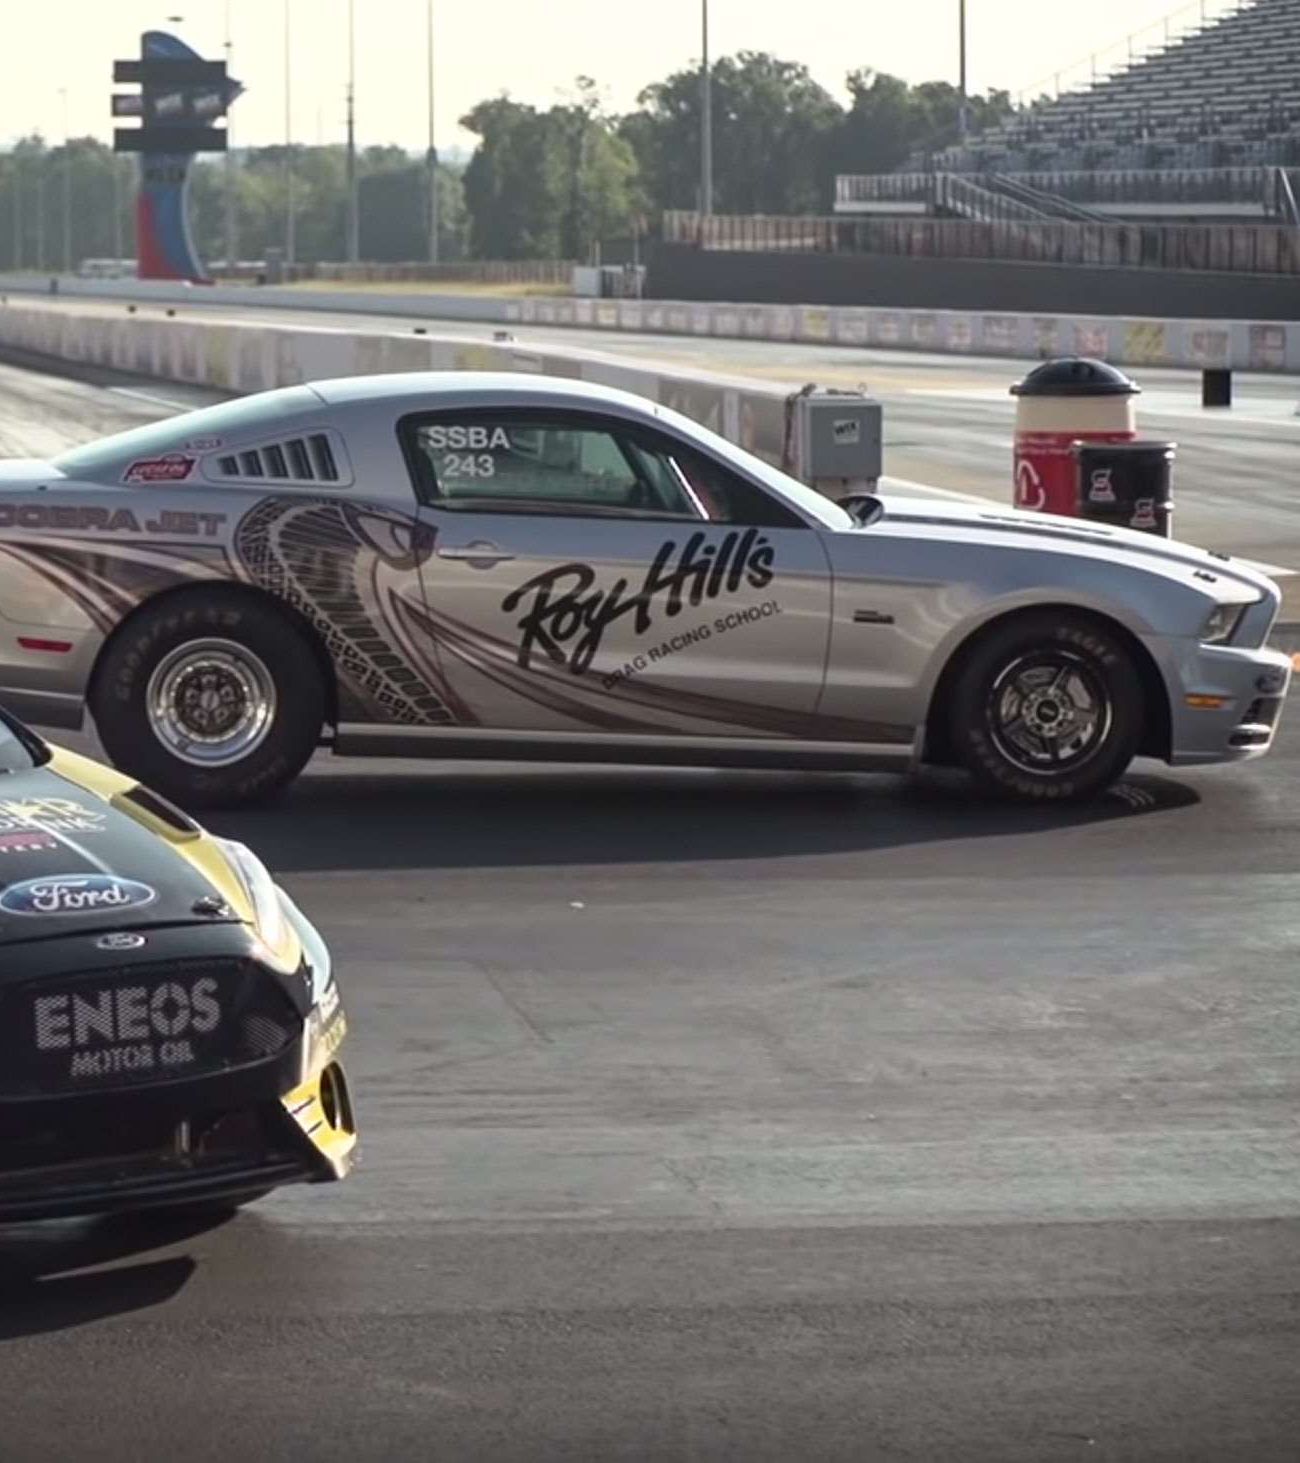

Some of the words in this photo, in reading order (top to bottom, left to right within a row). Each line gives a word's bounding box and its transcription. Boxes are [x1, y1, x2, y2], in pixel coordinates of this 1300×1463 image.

[428, 426, 511, 450] SSBA
[442, 455, 495, 478] 243
[145, 509, 227, 536] JET
[502, 563, 632, 675] Roy
[635, 529, 775, 635] Hill's
[602, 658, 648, 691] DRAG
[649, 627, 713, 664] RACING
[715, 600, 783, 635] SCHOOL
[30, 880, 129, 911] Ford
[34, 978, 221, 1050] ENEOS
[70, 1044, 154, 1077] MOTOR
[159, 1040, 194, 1064] OIL
